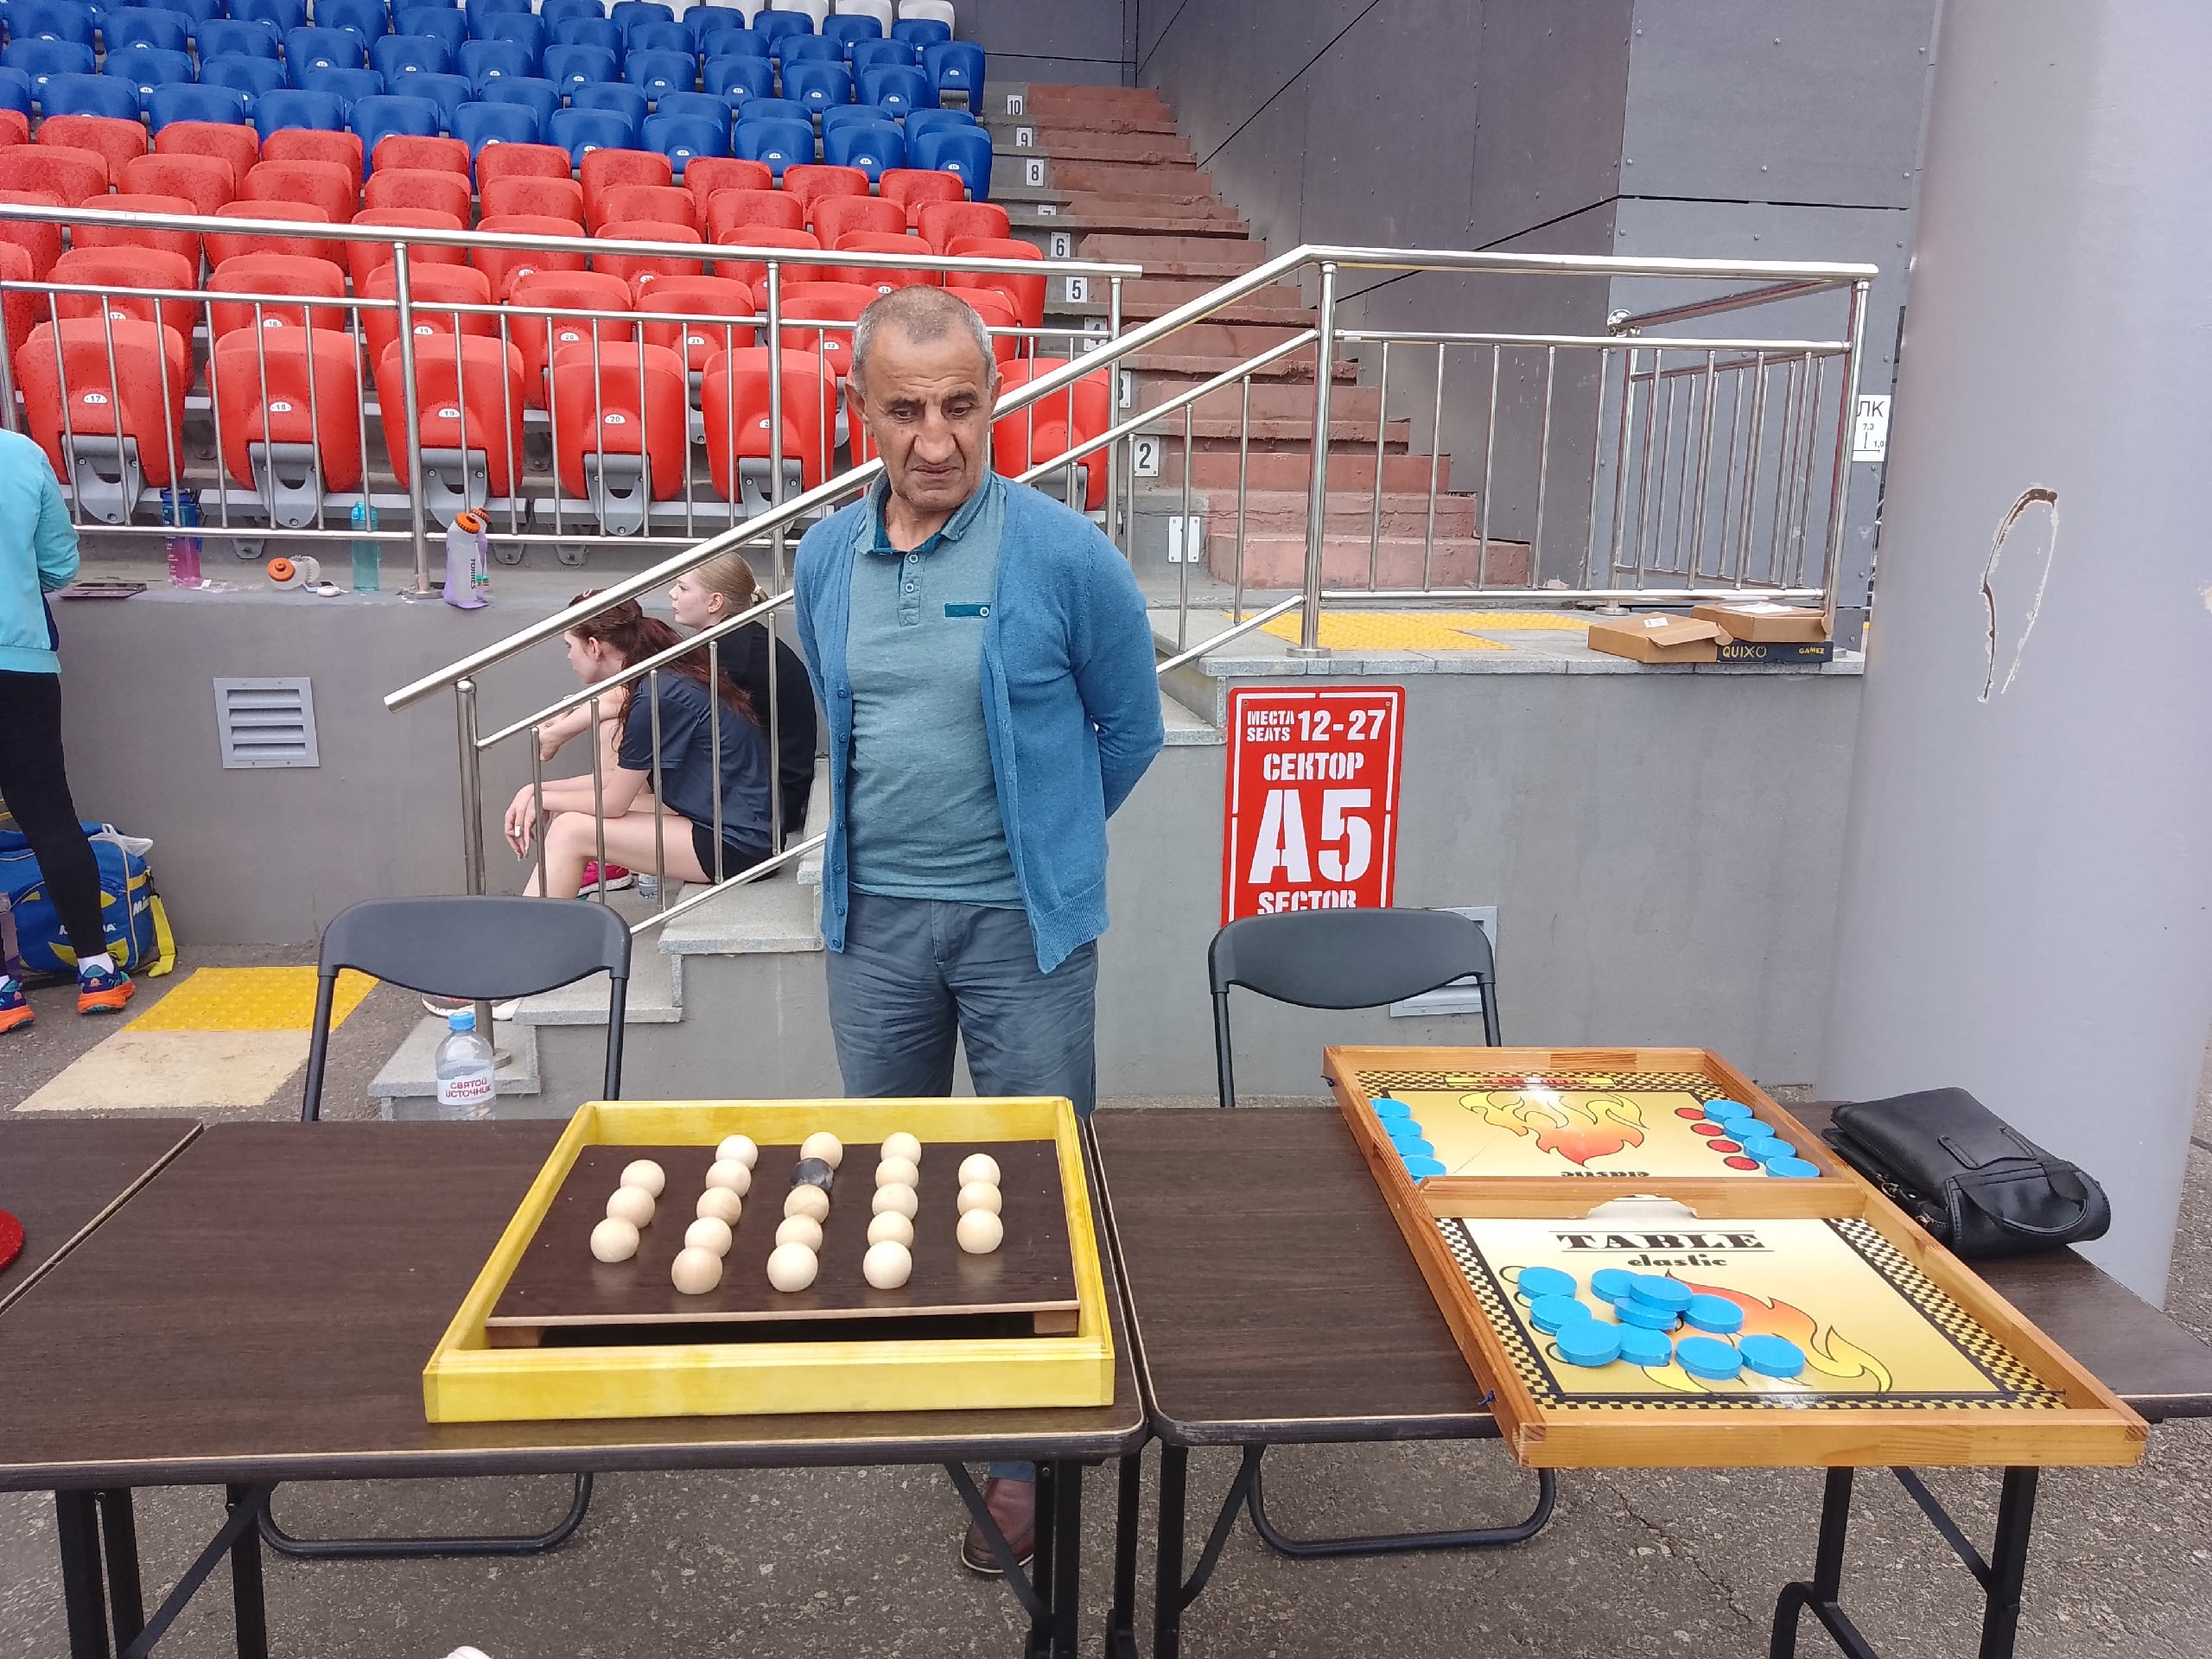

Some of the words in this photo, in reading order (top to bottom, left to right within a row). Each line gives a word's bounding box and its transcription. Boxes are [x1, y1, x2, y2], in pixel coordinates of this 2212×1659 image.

[1008, 99, 1021, 115] 10
[1020, 132, 1028, 147] 9
[1031, 164, 1039, 181] 8
[1055, 238, 1065, 257] 6
[1071, 279, 1082, 300] 5
[1138, 442, 1152, 469] 2
[1246, 710, 1294, 726] МЕСТА
[1297, 709, 1386, 741] 12-27
[1246, 727, 1291, 742] SEATS
[1263, 752, 1364, 781] СЕКТОР
[1248, 788, 1372, 884] A5
[1256, 889, 1357, 915] SECTOR
[445, 1085, 492, 1098] ИСТОЧНИК
[449, 1077, 487, 1090] СВЯТОЙ
[1555, 1234, 1766, 1249] TABLE
[1627, 1253, 1728, 1267] elastic
